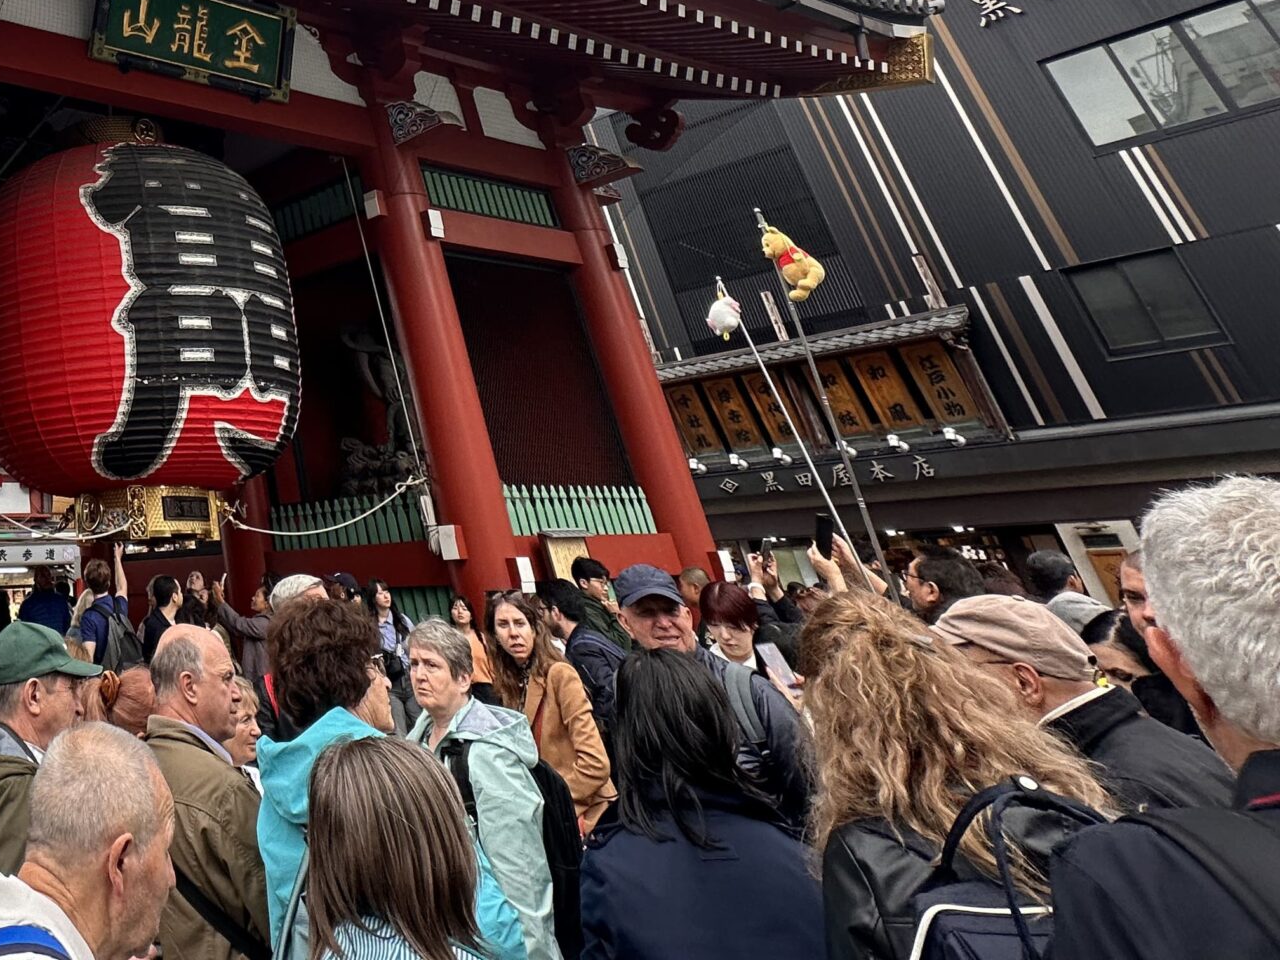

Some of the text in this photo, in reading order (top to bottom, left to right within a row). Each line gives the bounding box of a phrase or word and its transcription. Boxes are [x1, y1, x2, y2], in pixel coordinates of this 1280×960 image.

[918, 354, 966, 417] 江戸小物
[761, 455, 935, 493] 黒田屋本店
